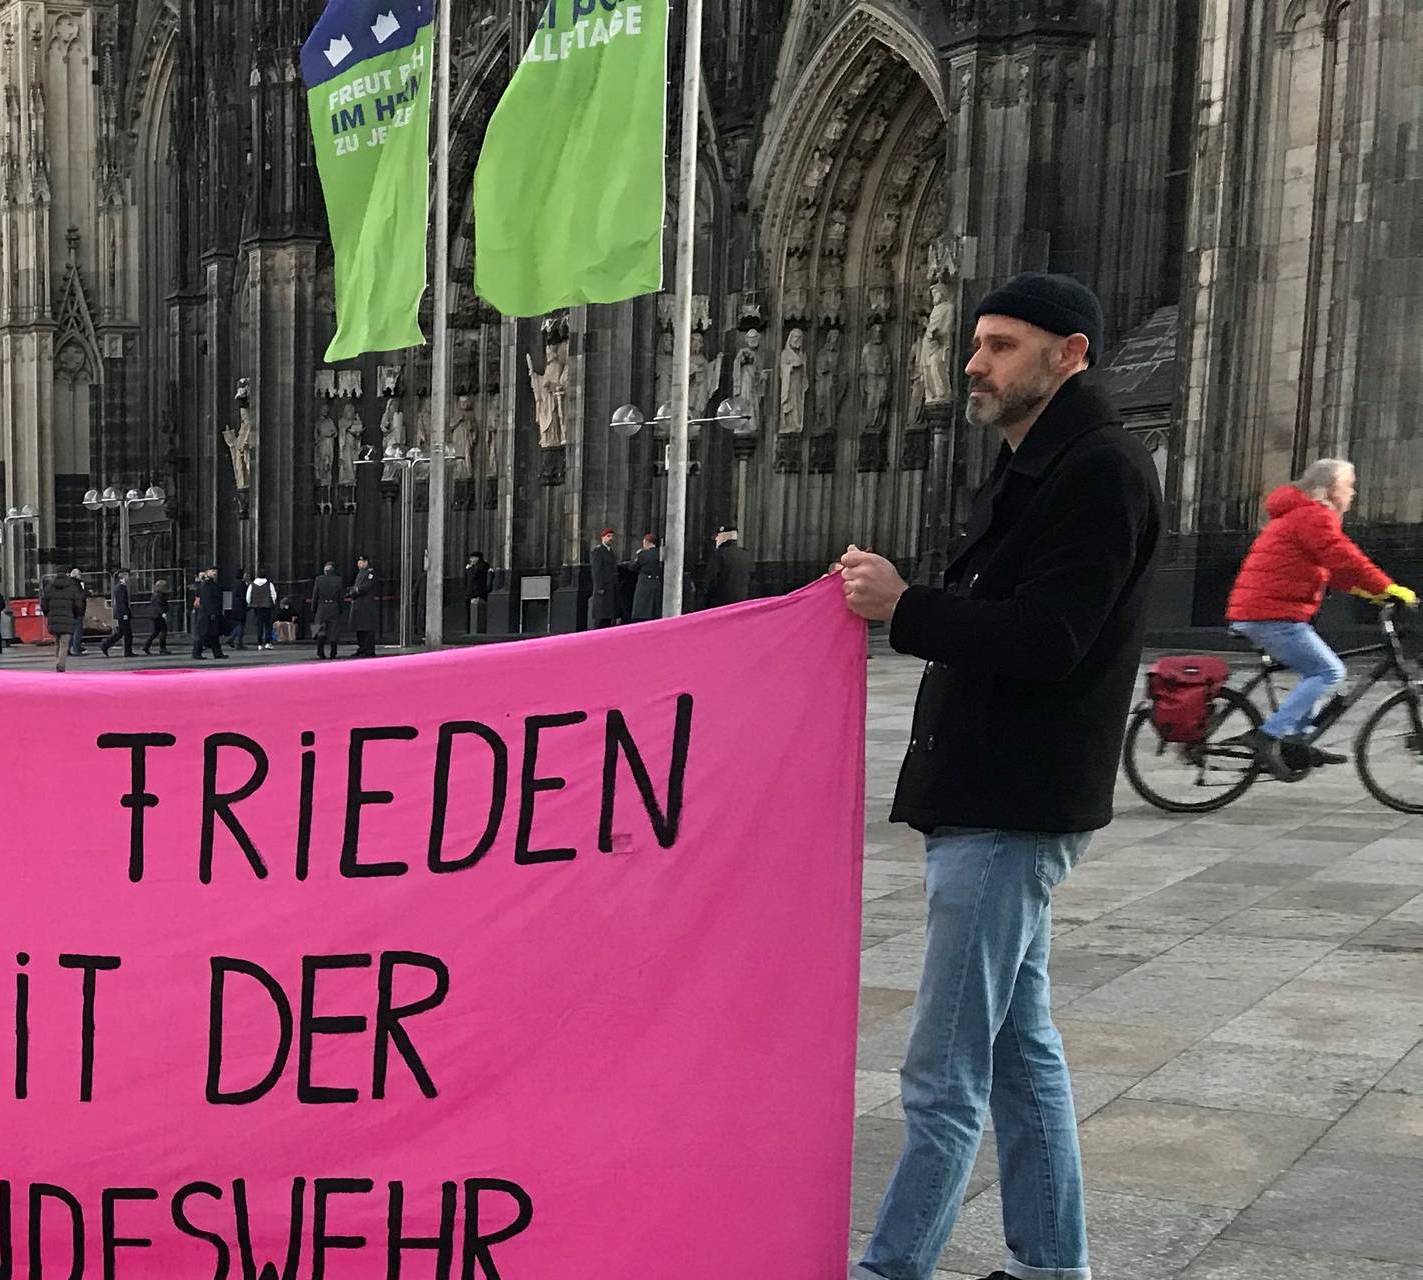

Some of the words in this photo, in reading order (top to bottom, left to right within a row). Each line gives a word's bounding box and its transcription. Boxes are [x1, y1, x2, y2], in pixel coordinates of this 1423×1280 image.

[329, 69, 391, 111] FREUT
[331, 103, 366, 135] IM
[334, 133, 359, 156] ZU
[205, 950, 450, 1106] DER
